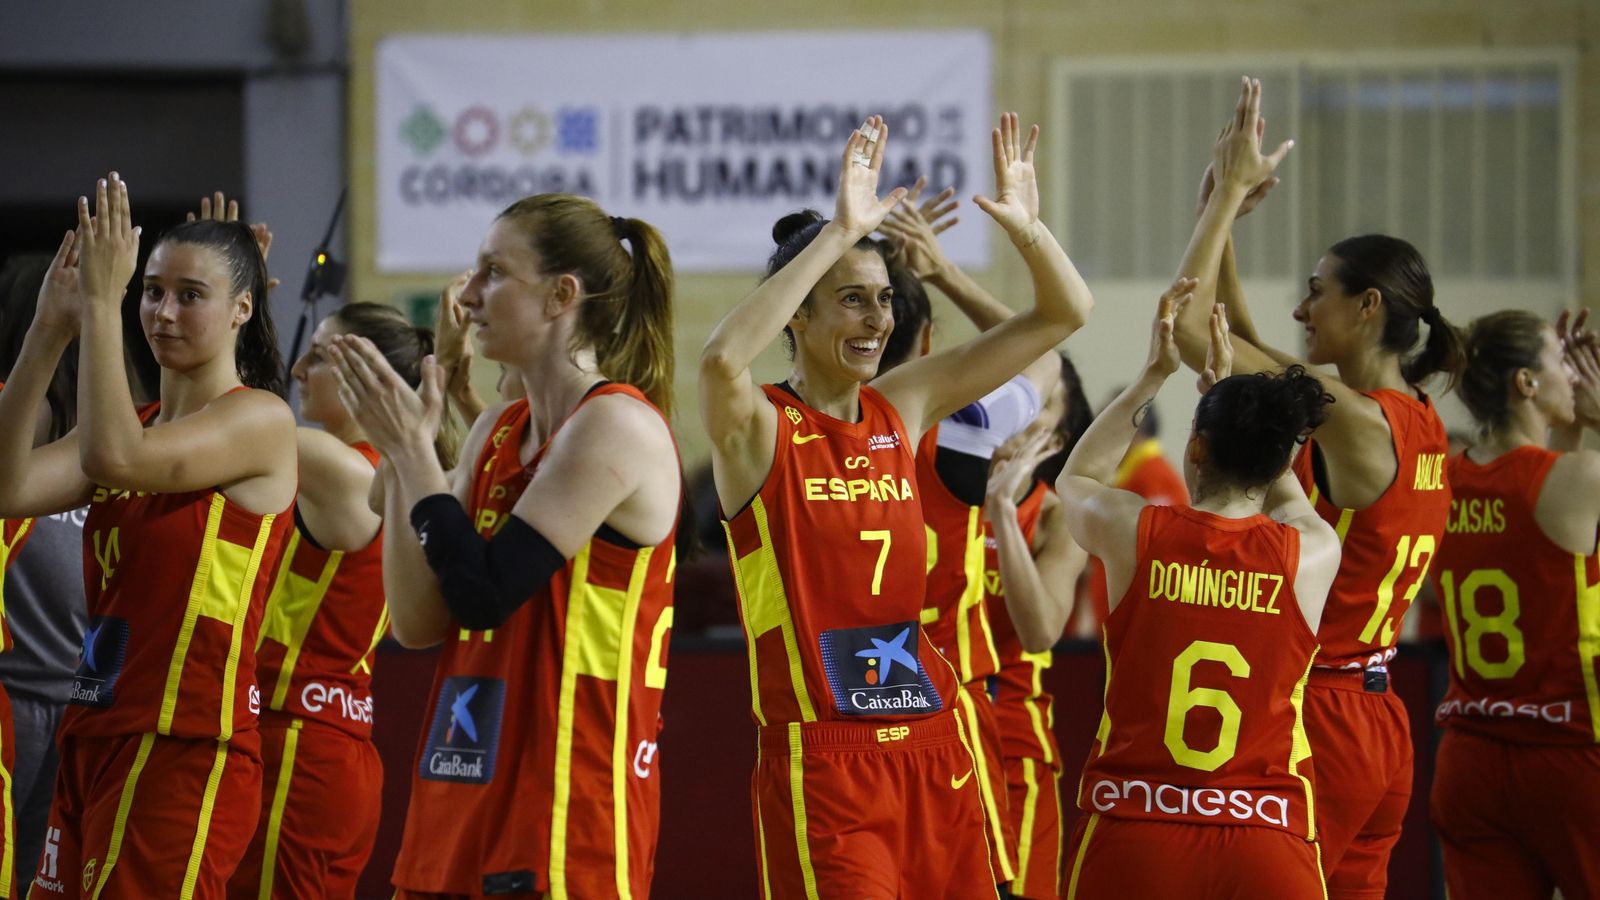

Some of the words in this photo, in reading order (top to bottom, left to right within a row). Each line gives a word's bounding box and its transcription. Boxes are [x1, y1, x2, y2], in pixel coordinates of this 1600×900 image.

[633, 155, 965, 202] HUMANAD
[805, 474, 914, 502] ESPAÑA
[1446, 498, 1506, 533] CASAS
[860, 530, 891, 596] 7
[1148, 559, 1284, 615] DOMÍNGUEZ
[1358, 535, 1435, 647] 13
[1440, 569, 1525, 680] 18
[1163, 640, 1251, 772] 6
[876, 726, 910, 743] ESP
